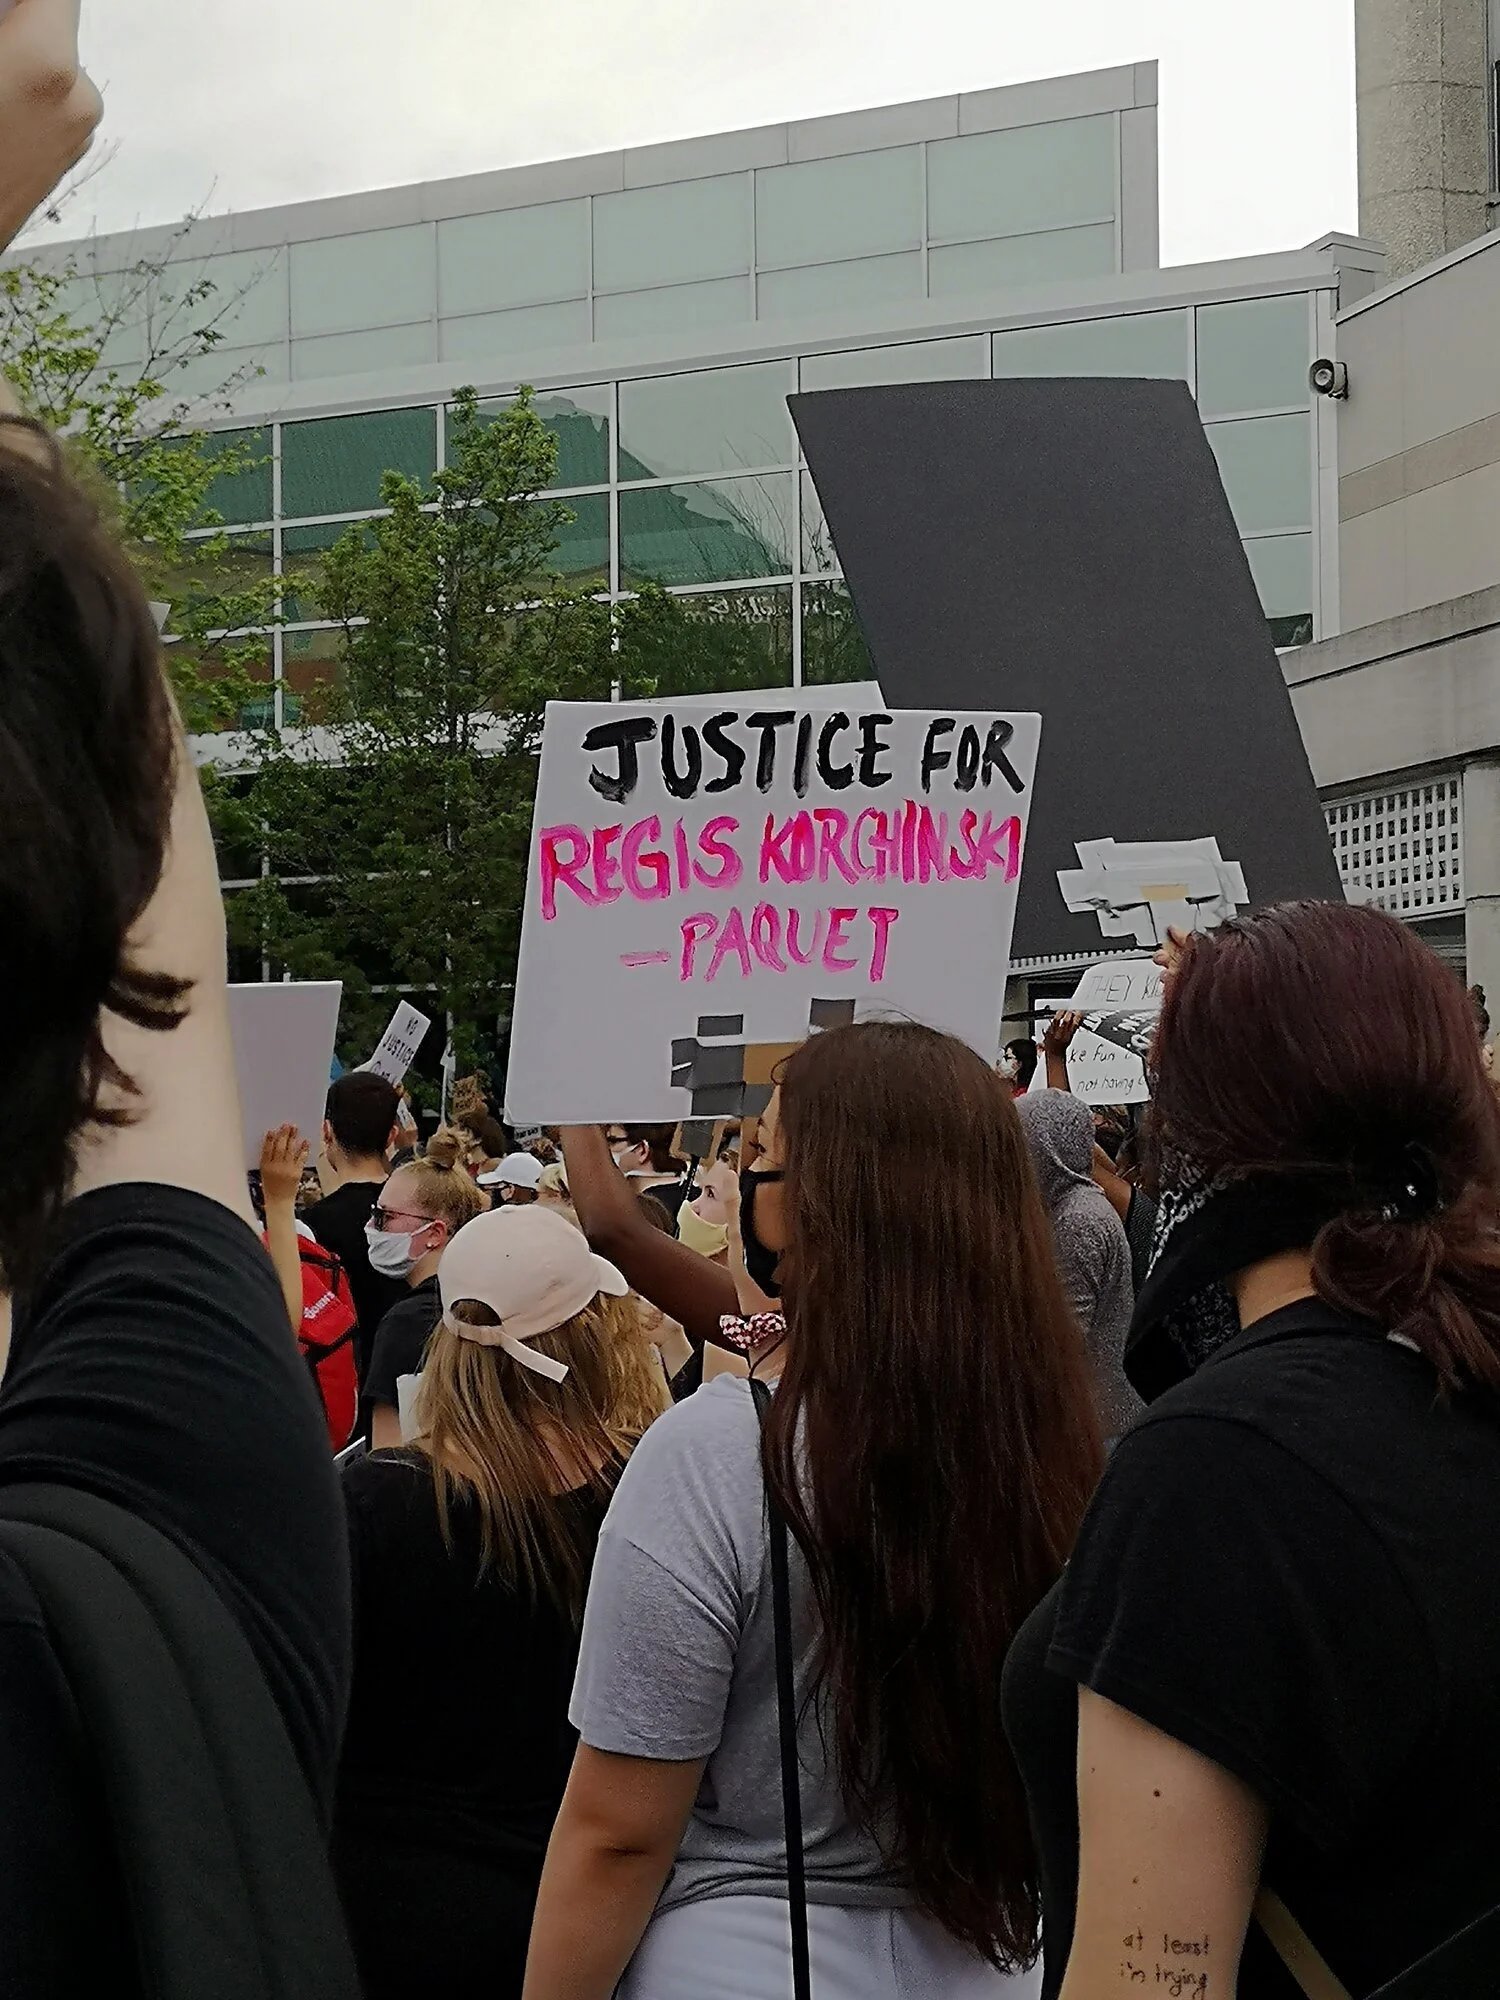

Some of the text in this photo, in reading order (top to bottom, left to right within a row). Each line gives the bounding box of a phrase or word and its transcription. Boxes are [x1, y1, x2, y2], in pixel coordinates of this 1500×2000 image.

[581, 710, 1025, 805] JUSTICE FOR
[538, 798, 1022, 921] REGIS KORCHINSKI
[1087, 974, 1136, 1003] THEY
[383, 1033, 415, 1067] JUSTICE
[1093, 1043, 1116, 1062] fun
[1076, 1078, 1098, 1092] not
[1101, 1074, 1134, 1096] having
[1122, 1927, 1209, 1955] at least
[1119, 1962, 1208, 2000] i'm trying
